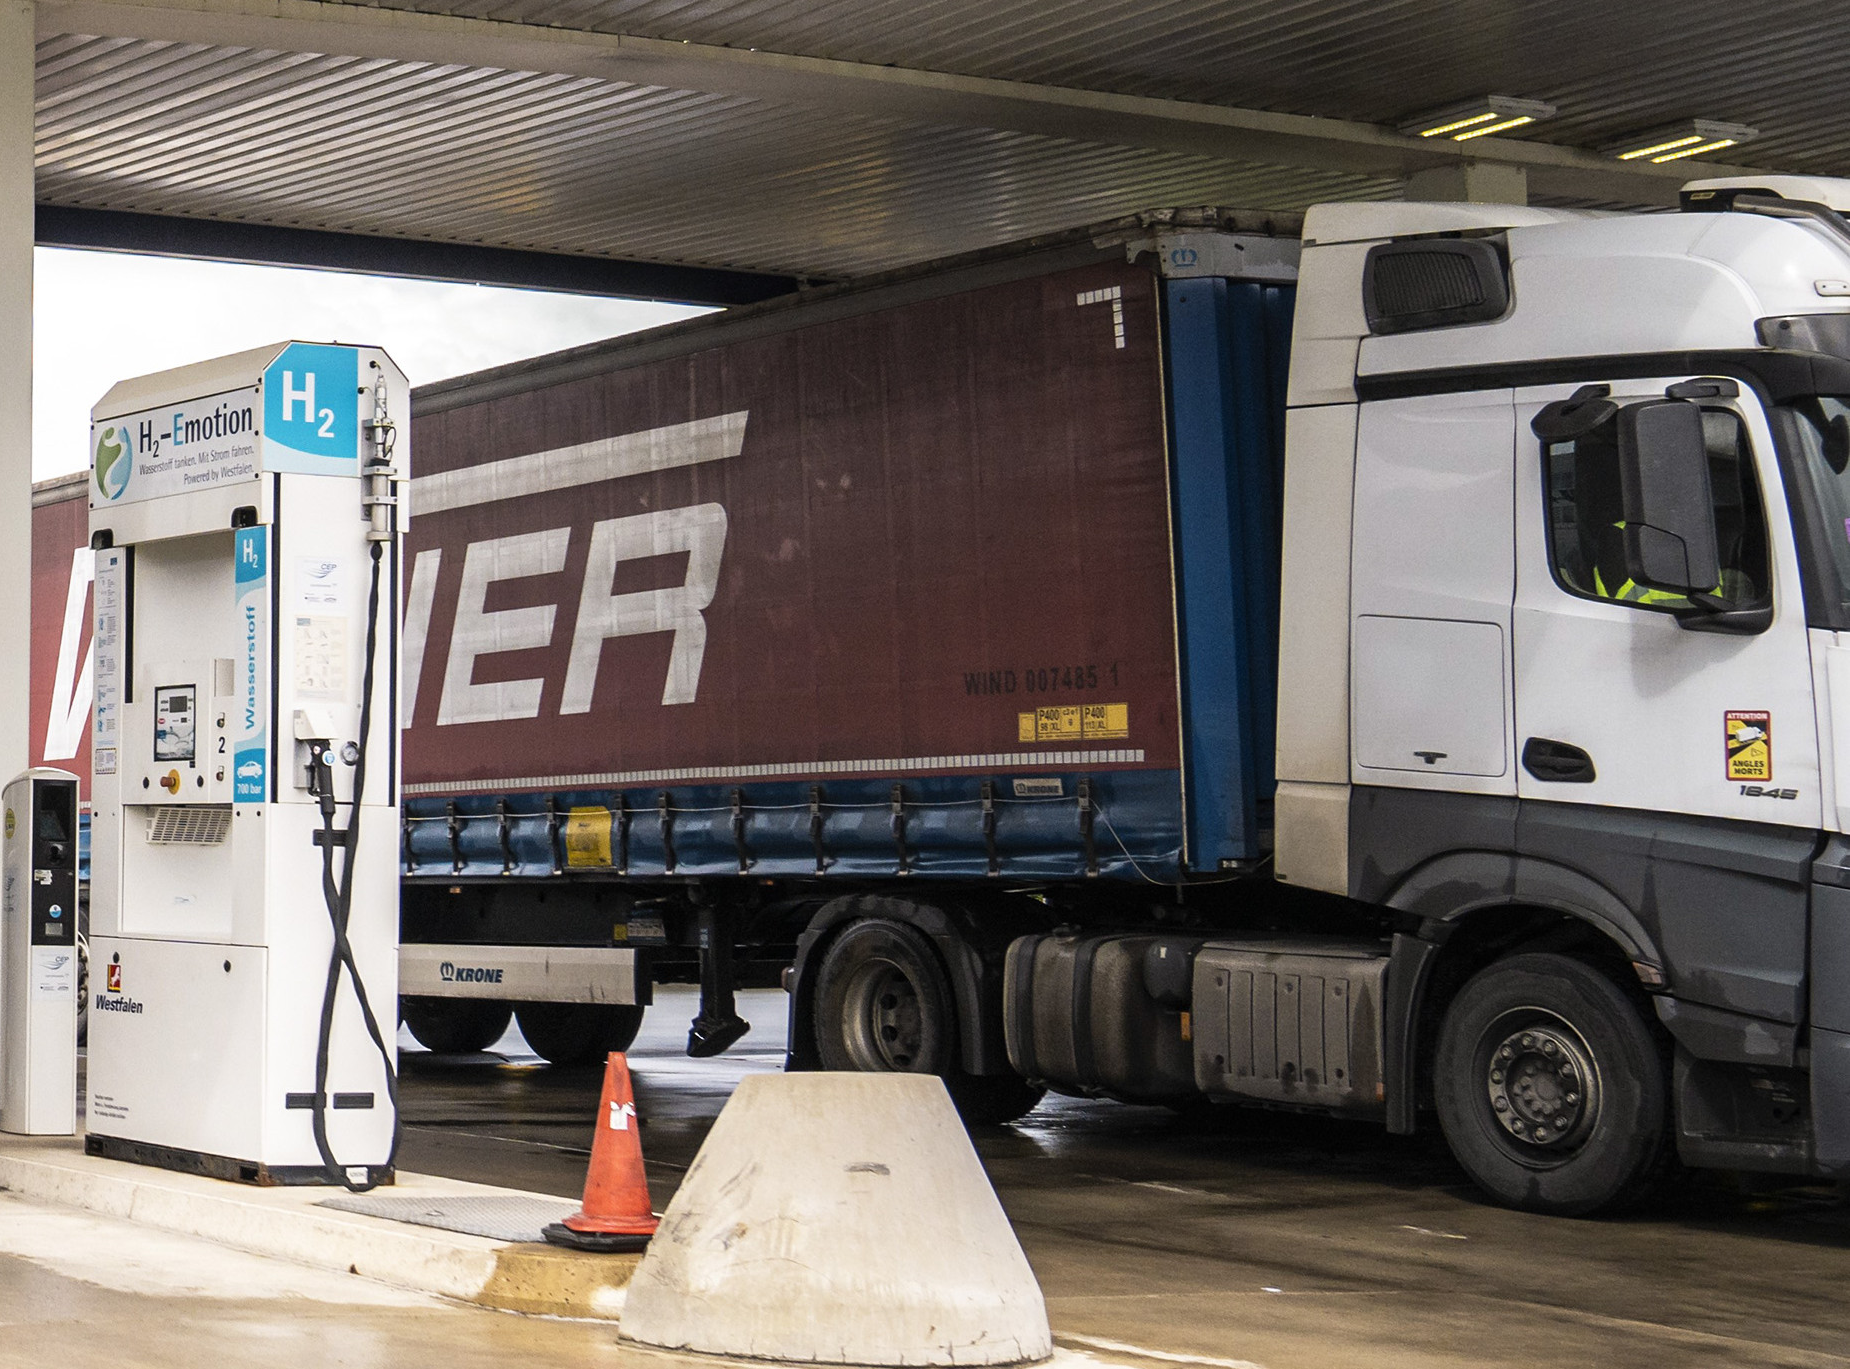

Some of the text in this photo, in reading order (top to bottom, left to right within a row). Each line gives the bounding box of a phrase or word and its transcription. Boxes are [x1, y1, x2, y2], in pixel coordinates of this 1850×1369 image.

[139, 457, 173, 476] Wasserstoff
[198, 452, 210, 464] Mit
[210, 449, 230, 462] Strom
[183, 469, 210, 485] Powered
[211, 468, 219, 481] by
[245, 605, 256, 730] Wasserstoff
[964, 670, 1017, 696] WIND
[1025, 665, 1098, 693] 007485
[218, 736, 225, 753] 2
[237, 783, 262, 794] 700 bar
[455, 967, 504, 984] KRONE
[96, 994, 143, 1014] Westfalen
